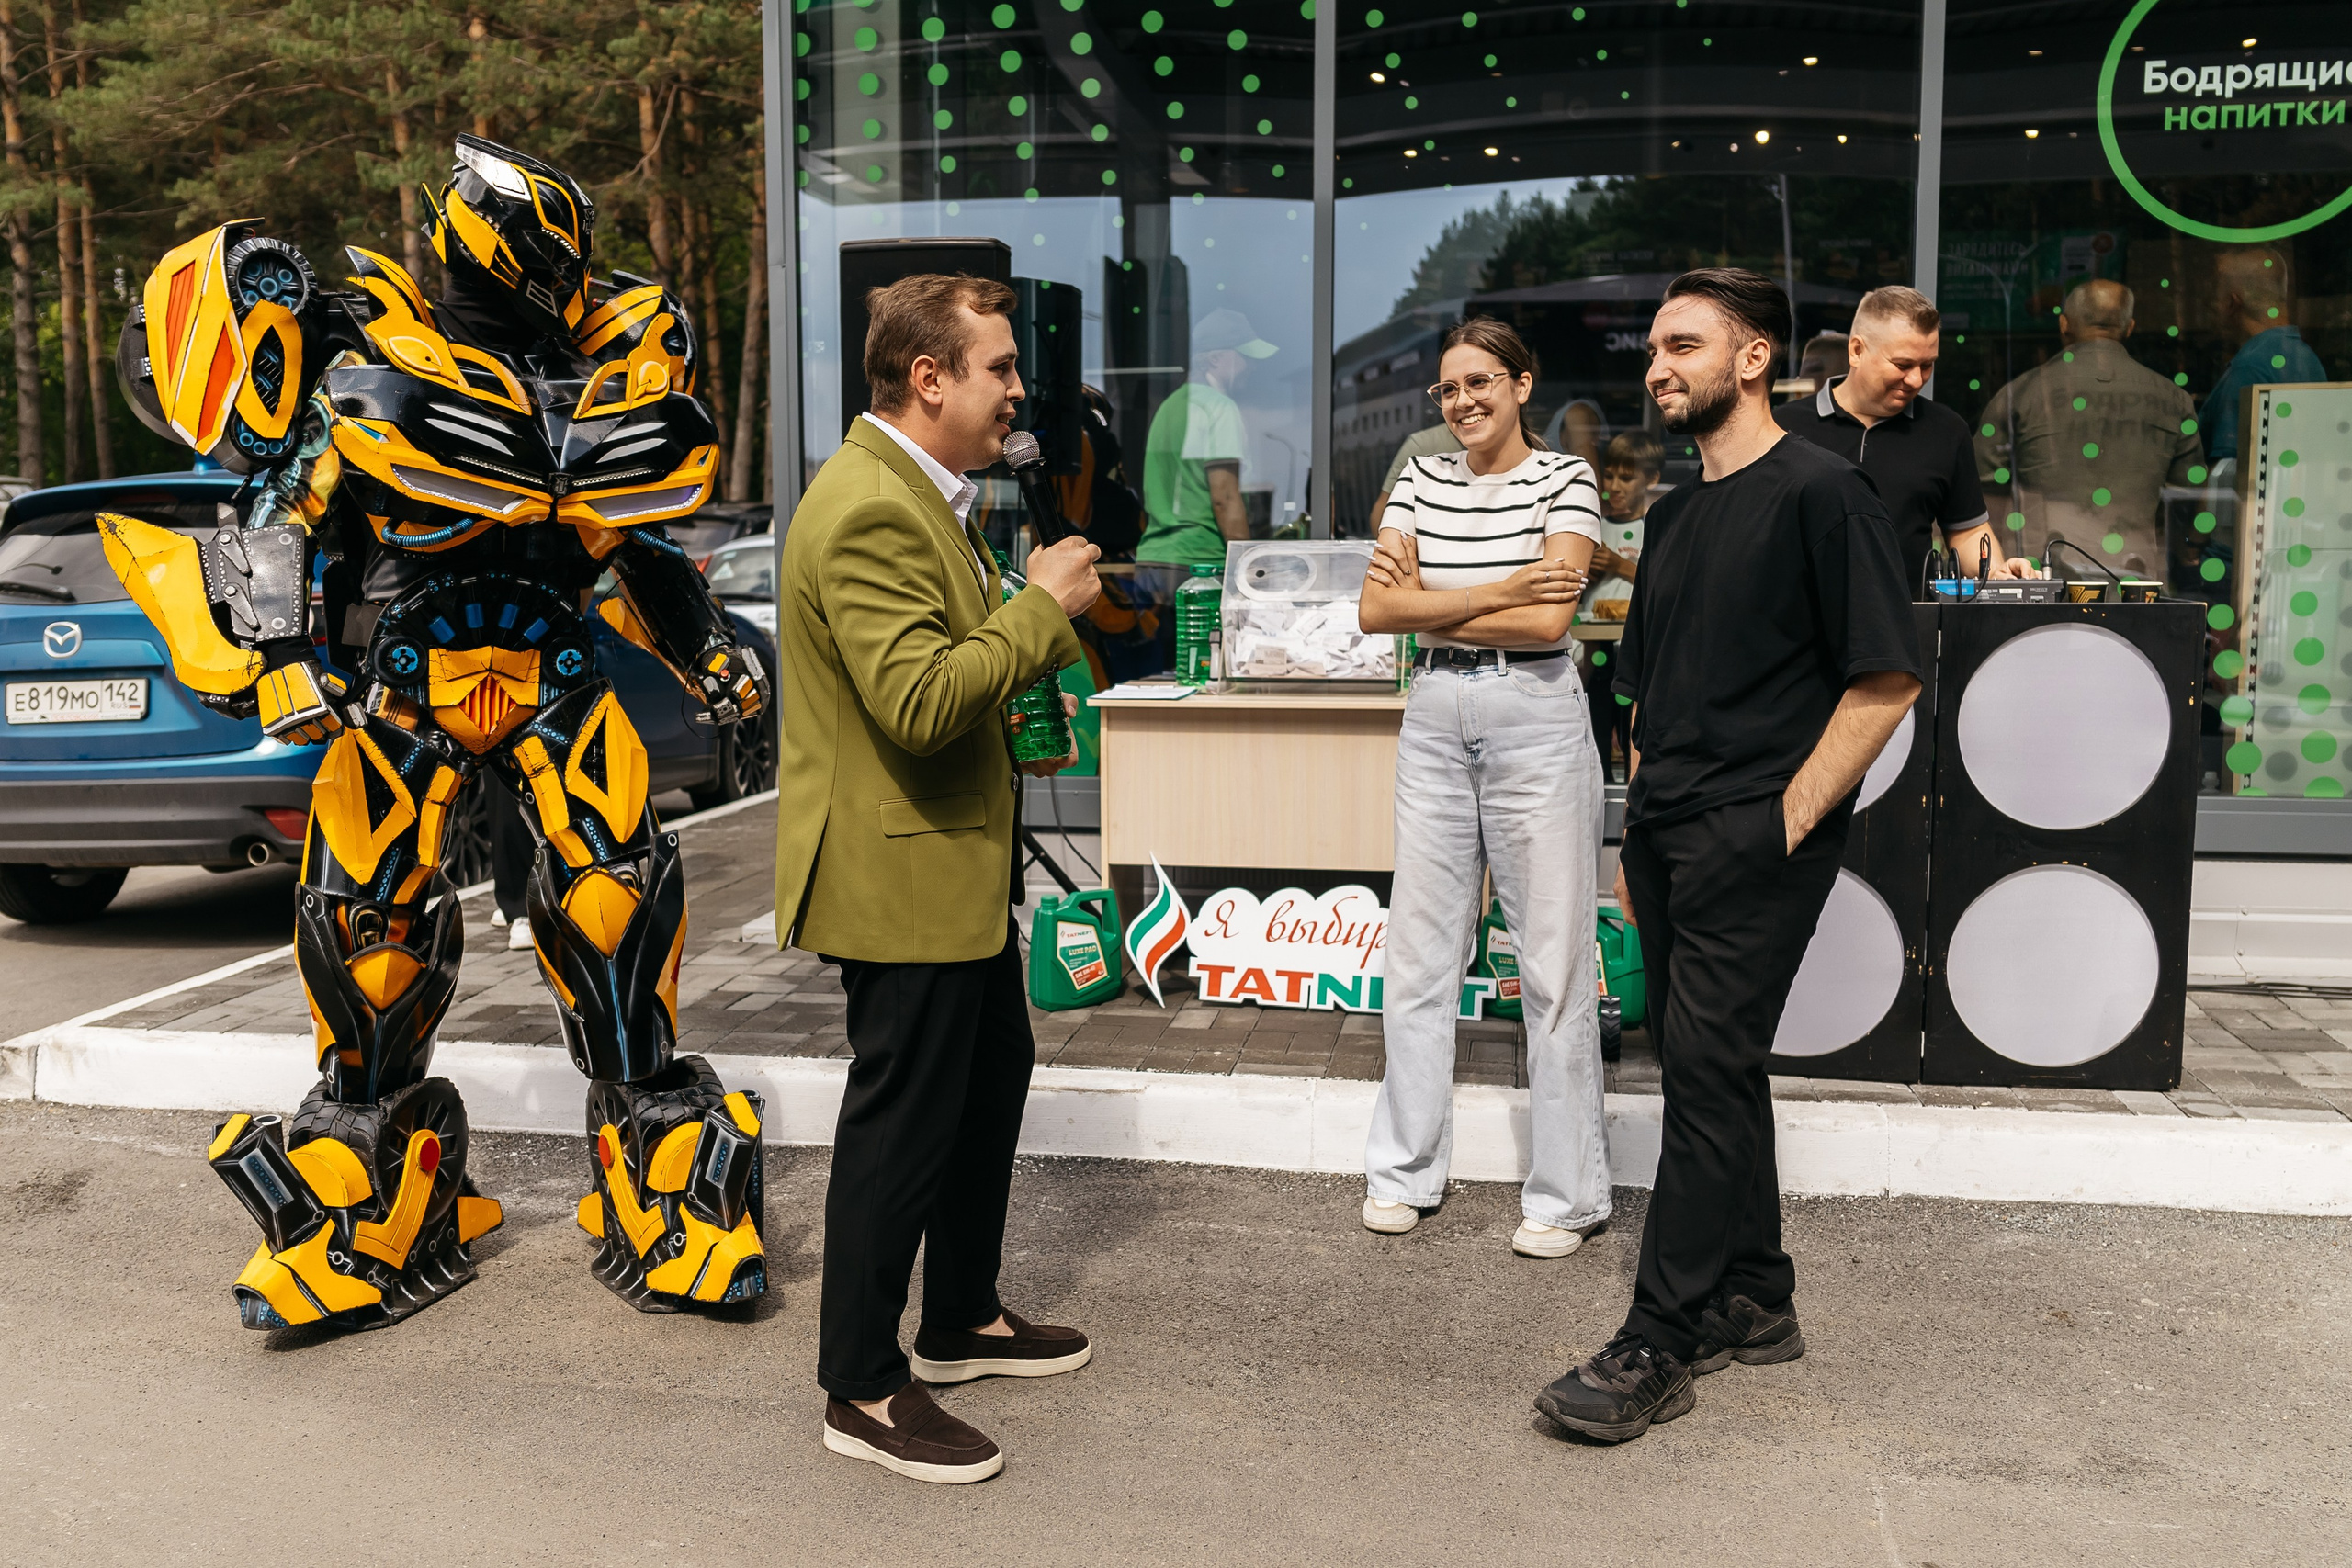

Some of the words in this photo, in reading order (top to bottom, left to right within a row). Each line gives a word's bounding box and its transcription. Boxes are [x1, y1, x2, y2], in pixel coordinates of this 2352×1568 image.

[2165, 100, 2346, 130] напитки
[105, 682, 139, 702] 142
[1204, 899, 1239, 939] Я
[1265, 896, 1389, 969] выбир
[1069, 948, 1084, 956] LUXE
[1498, 956, 1514, 964] LUXE
[1197, 964, 1489, 1017] TATNT
